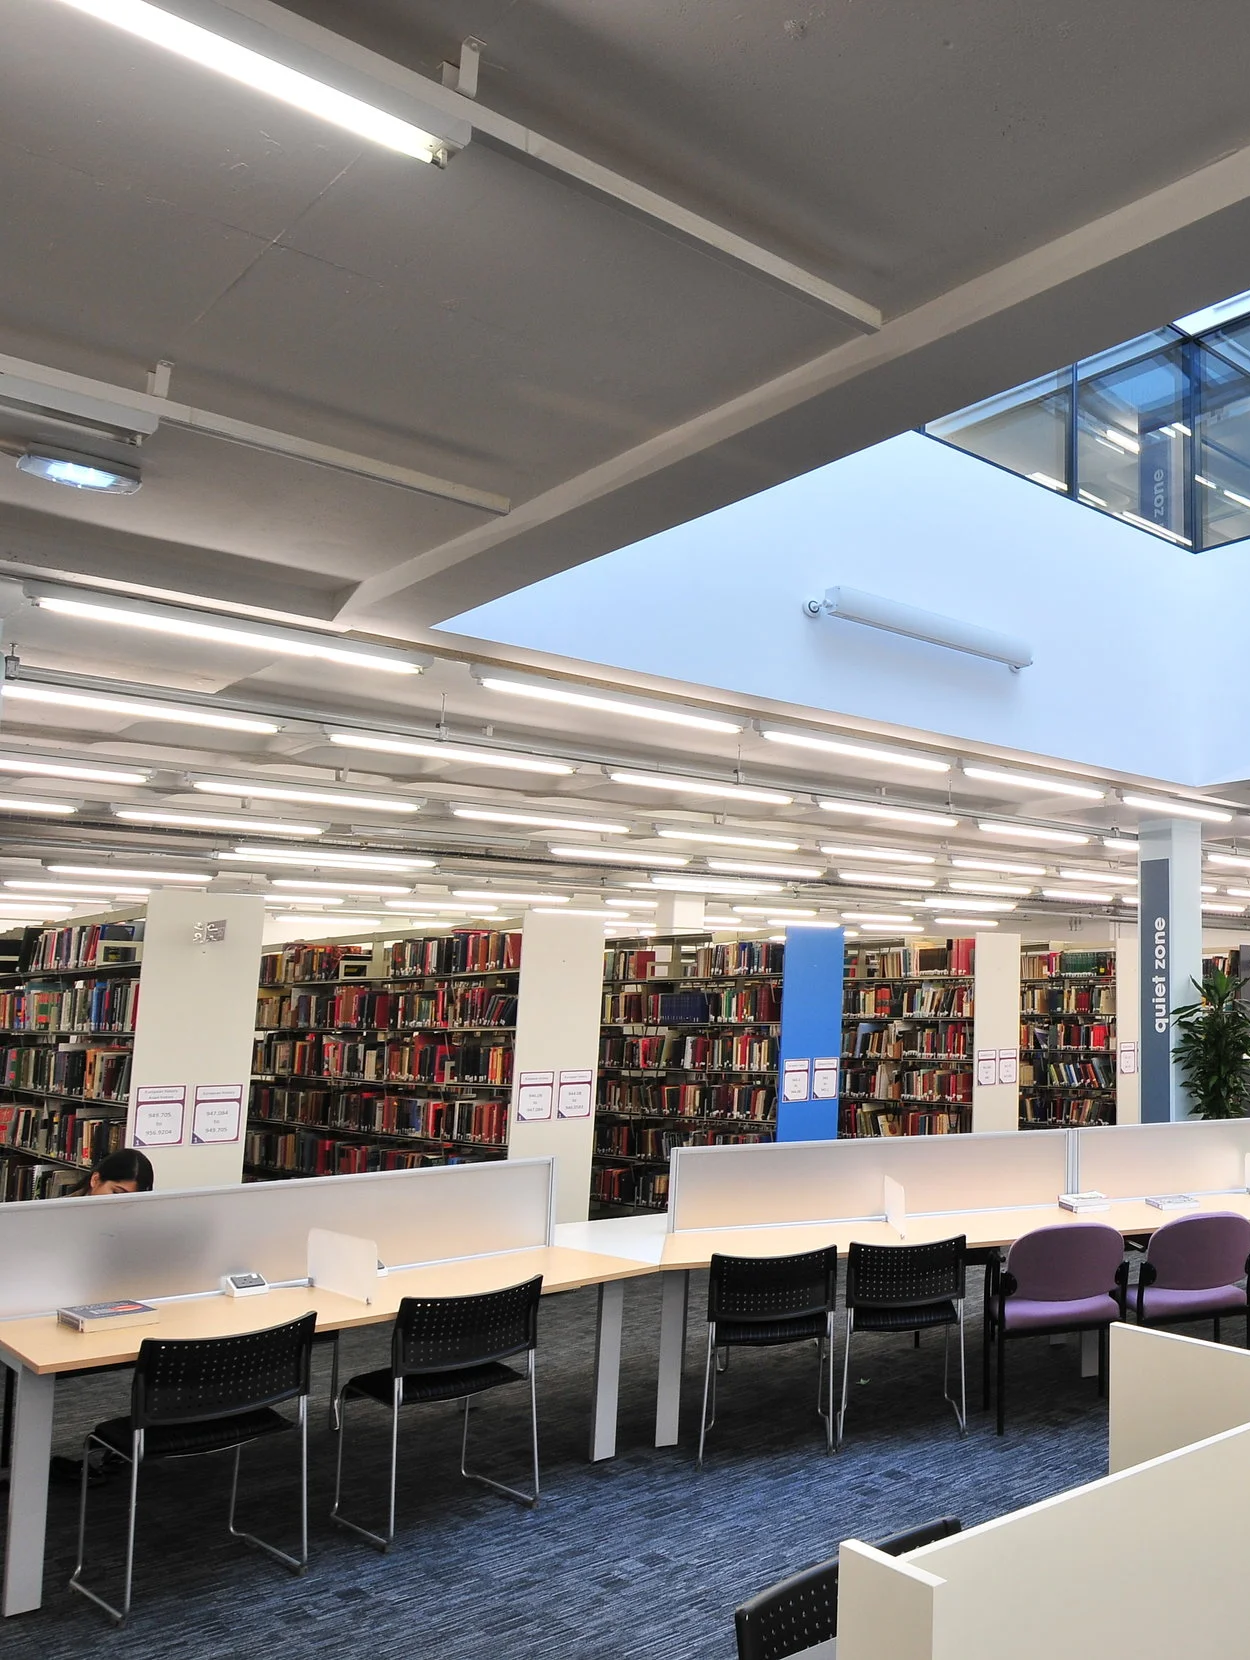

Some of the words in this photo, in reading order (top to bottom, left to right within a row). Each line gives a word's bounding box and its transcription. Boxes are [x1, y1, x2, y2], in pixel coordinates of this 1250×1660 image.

[1153, 468, 1164, 518] zone
[1154, 917, 1167, 969] zone
[1152, 975, 1169, 1033] quiet
